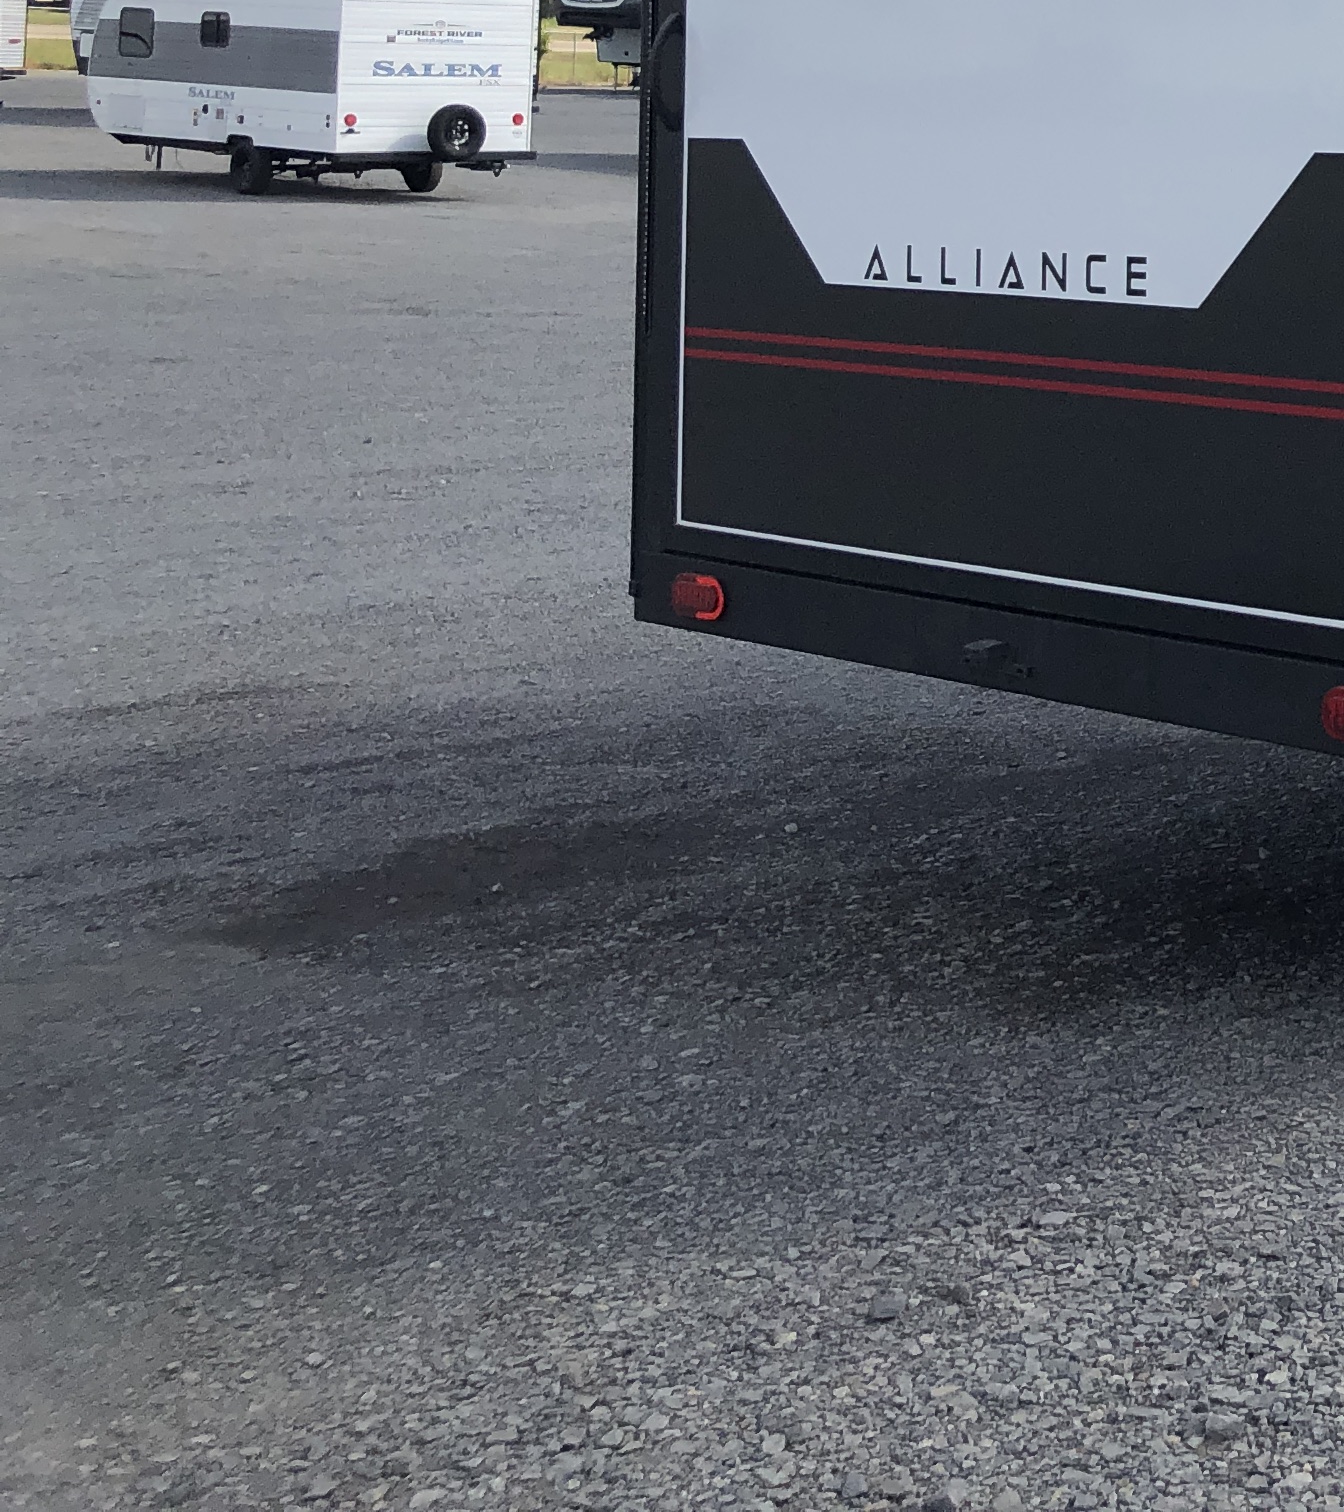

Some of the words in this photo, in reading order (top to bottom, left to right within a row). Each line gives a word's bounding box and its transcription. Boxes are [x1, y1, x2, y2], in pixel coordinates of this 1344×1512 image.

[397, 29, 444, 37] FOREST
[447, 30, 483, 38] RIVER
[372, 60, 502, 78] SALEM
[188, 87, 236, 100] SALEM
[864, 243, 1148, 297] ALLIANCE
